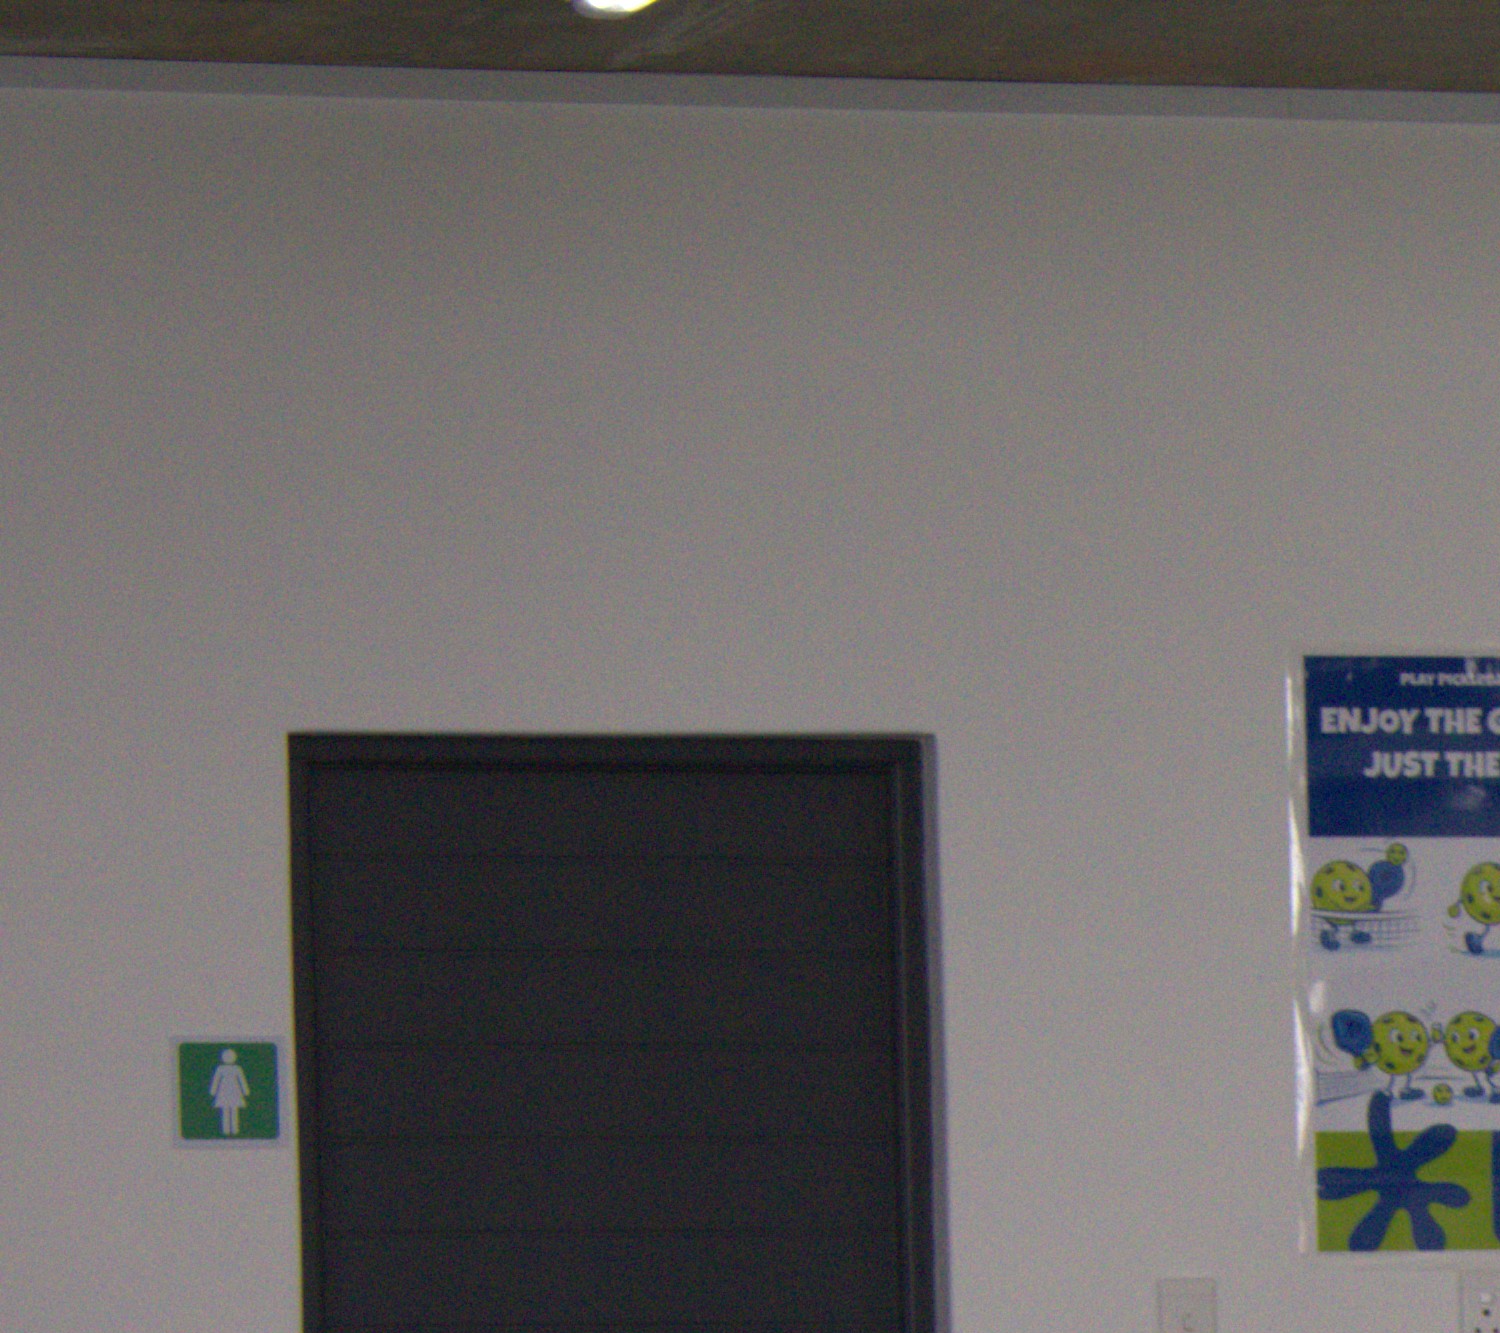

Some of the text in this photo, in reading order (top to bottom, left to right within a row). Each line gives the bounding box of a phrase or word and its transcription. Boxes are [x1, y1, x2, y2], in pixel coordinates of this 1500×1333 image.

[1320, 706, 1419, 735] ENJOY
[1424, 706, 1483, 735] THE
[1363, 750, 1440, 778] JUST
[1444, 750, 1500, 778] THE
